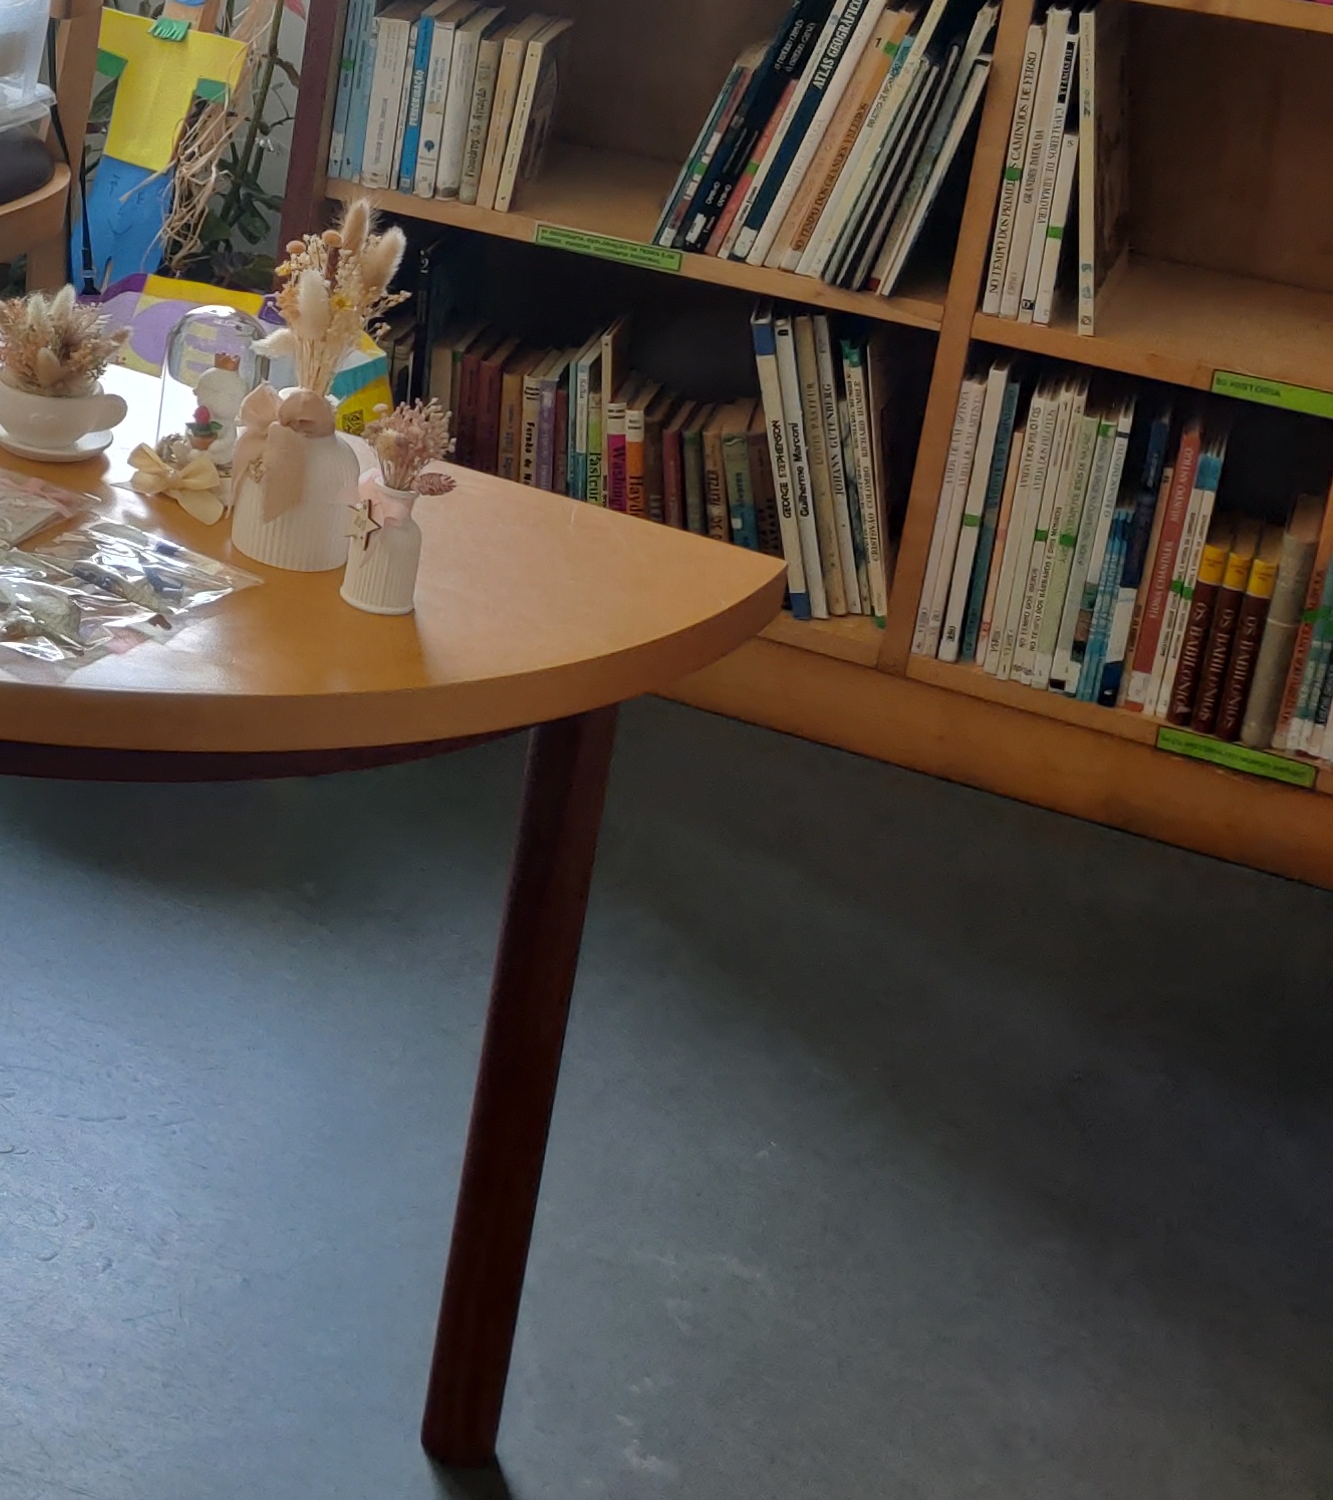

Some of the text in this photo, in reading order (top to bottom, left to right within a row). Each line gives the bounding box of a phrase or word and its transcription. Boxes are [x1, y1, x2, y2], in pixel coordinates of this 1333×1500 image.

[407, 68, 424, 126] PEREGRINAÇÃO
[809, 56, 837, 91] ATLAS
[464, 137, 481, 178] Pioneiros
[987, 49, 1038, 294] NO TEMPO DOS CAMINHOS DE FERRO
[1037, 106, 1063, 224] CAVALEIROS DE ARMADURA
[805, 381, 822, 465] LOUIS PASTEUR
[821, 382, 843, 495] JOHANN GUTENBERG
[770, 419, 792, 518] GEORGE STEPHENSON
[788, 422, 809, 517] Guilherme Marconi
[860, 465, 874, 509] COLOMBO
[1169, 445, 1195, 523] MUNDO ANTIGO
[1154, 538, 1175, 589] CHANDLER
[1191, 601, 1209, 623] OS
[1218, 607, 1236, 629] OS
[1241, 614, 1259, 636] OS
